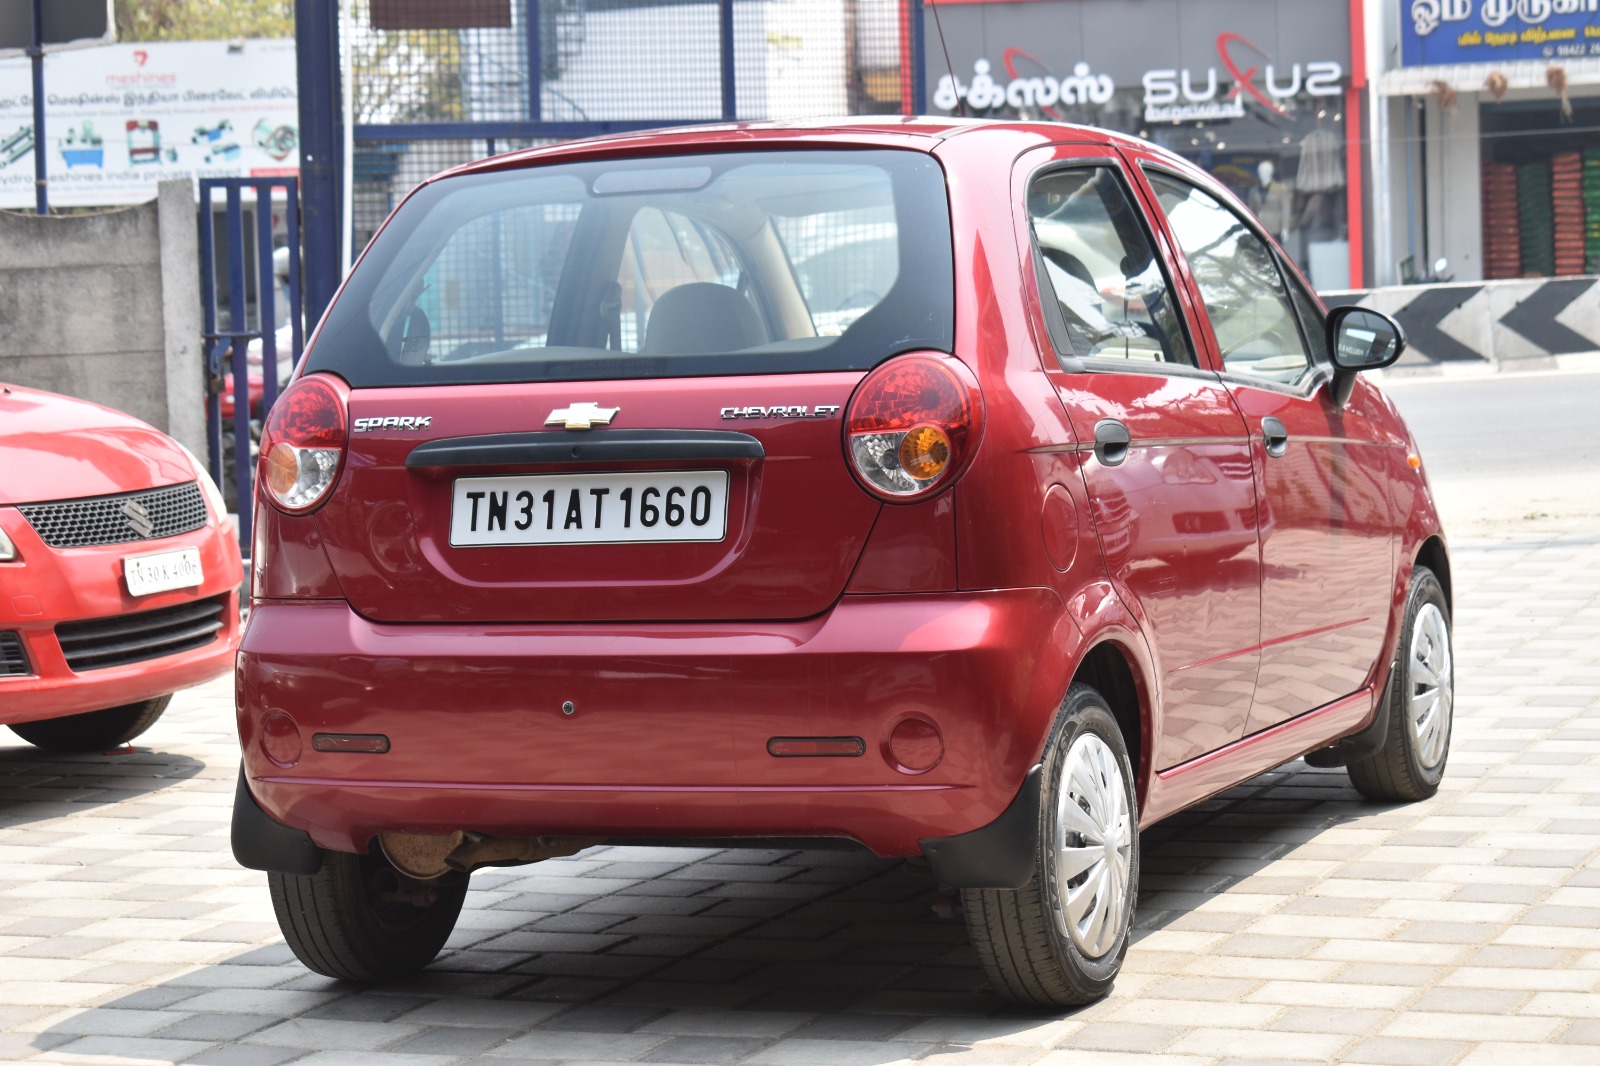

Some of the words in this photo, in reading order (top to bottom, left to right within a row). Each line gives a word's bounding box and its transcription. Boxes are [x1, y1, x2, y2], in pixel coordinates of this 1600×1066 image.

[106, 72, 177, 84] meshines
[47, 171, 103, 182] eshines
[720, 405, 840, 419] CHEVROLET
[354, 416, 432, 432] SPARK
